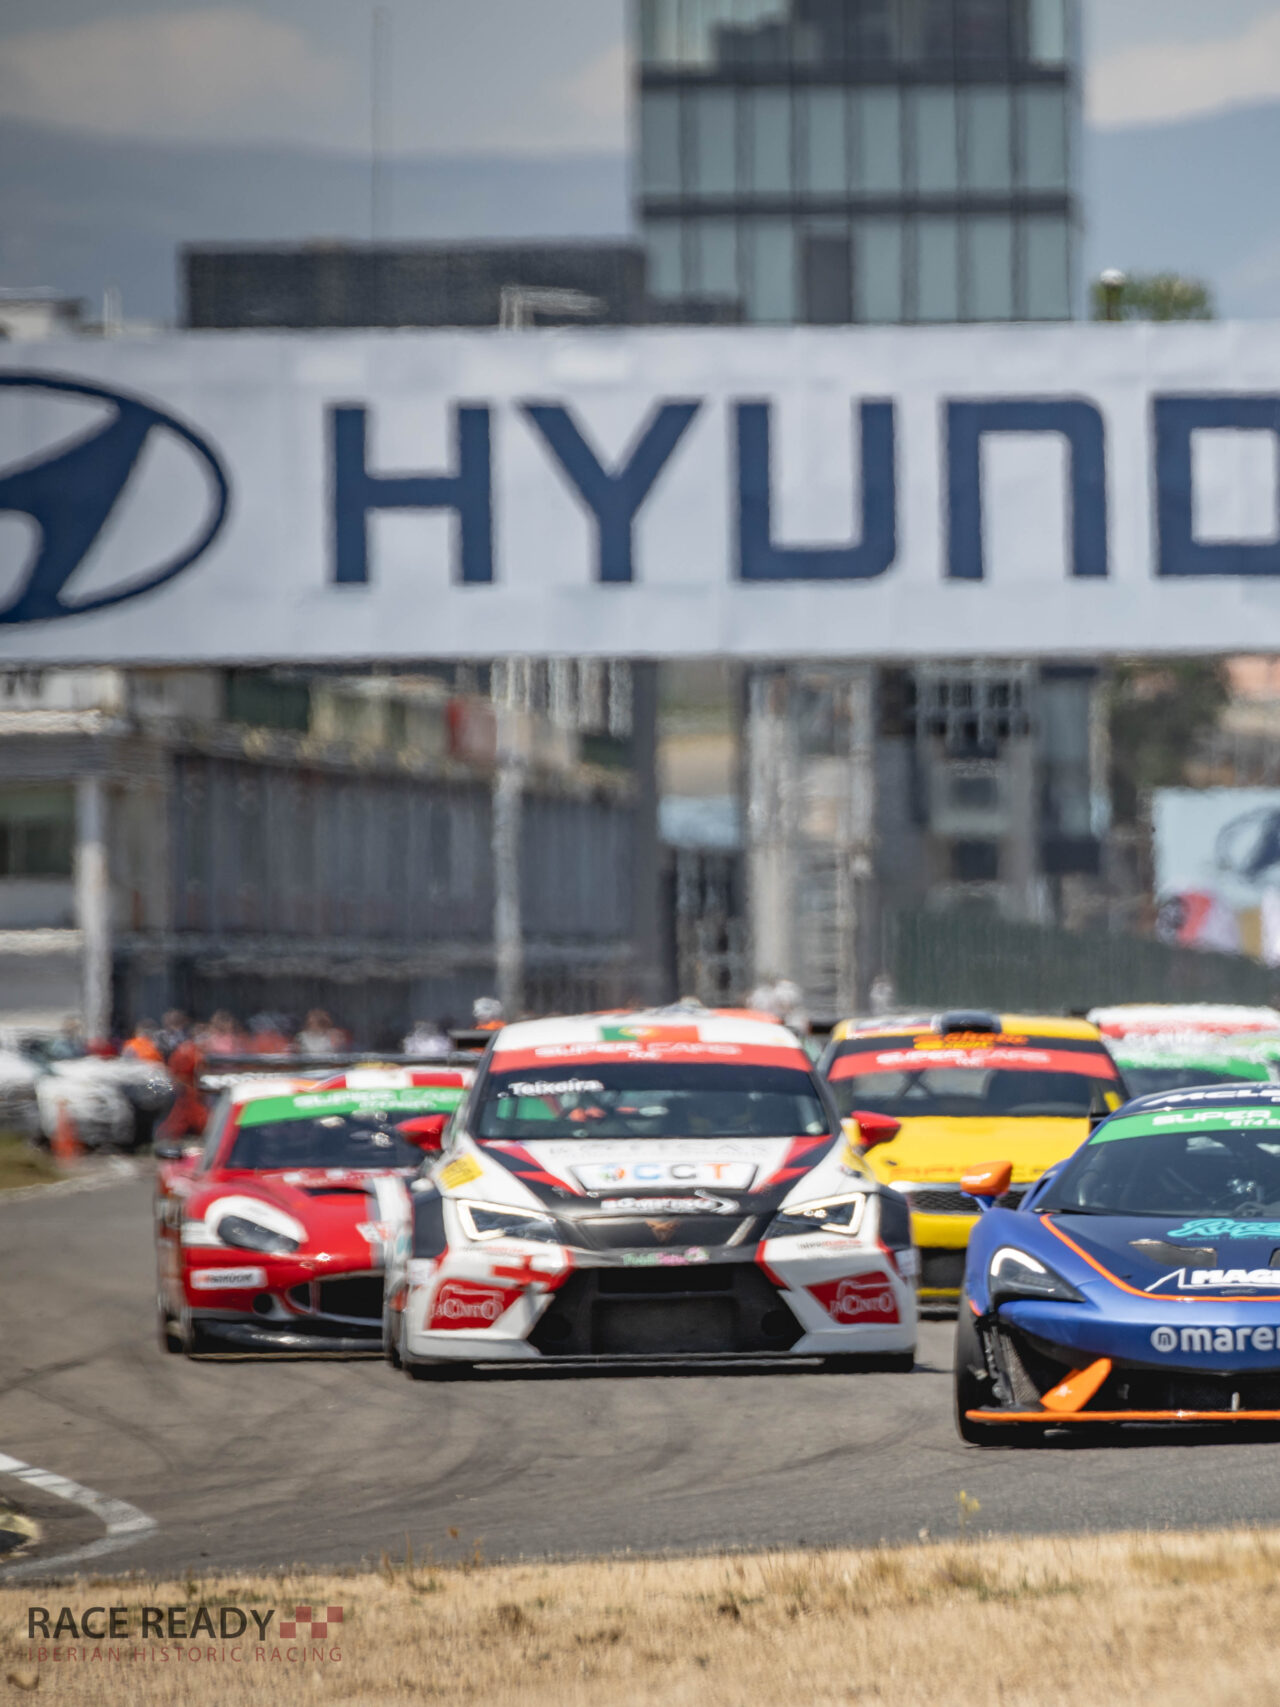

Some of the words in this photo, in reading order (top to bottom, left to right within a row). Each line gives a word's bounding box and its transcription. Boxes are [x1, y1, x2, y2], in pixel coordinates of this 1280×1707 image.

[535, 1042, 642, 1057] SUPER
[647, 1041, 743, 1055] CARS
[876, 1050, 968, 1064] SUPER
[508, 1079, 604, 1097] Teixeira
[1152, 1110, 1272, 1126] SUPER
[1230, 1118, 1264, 1127] GT4
